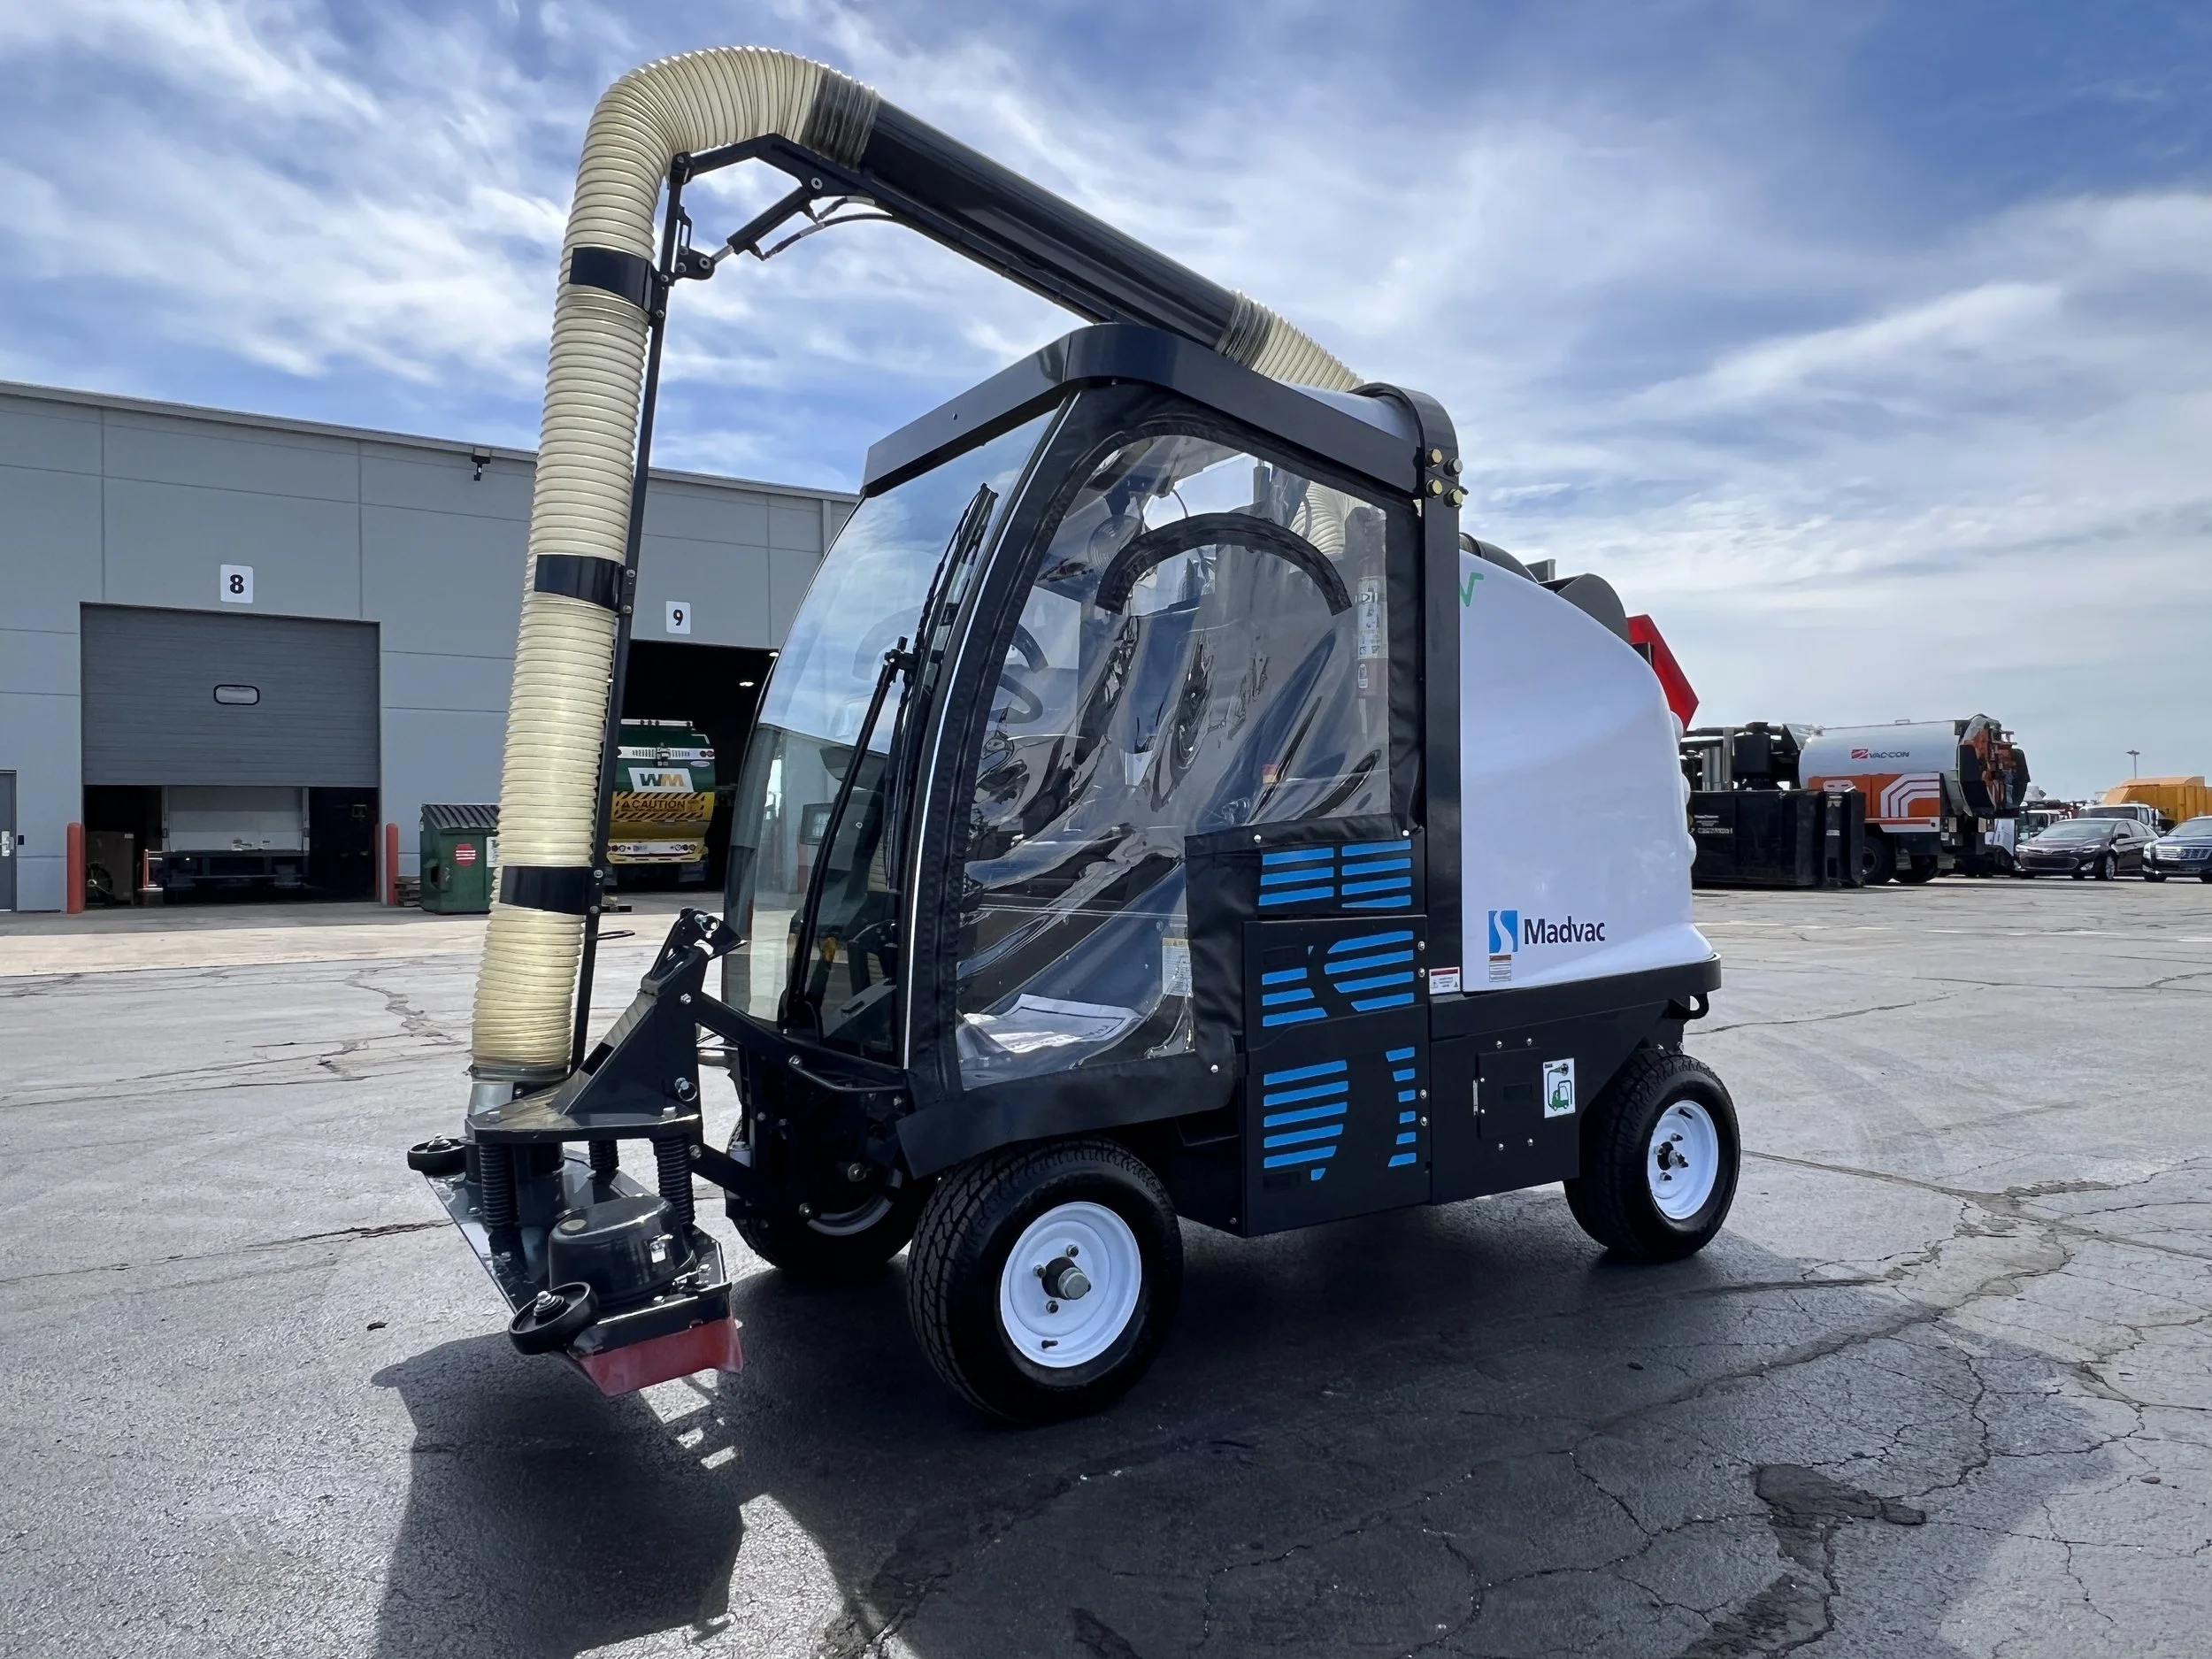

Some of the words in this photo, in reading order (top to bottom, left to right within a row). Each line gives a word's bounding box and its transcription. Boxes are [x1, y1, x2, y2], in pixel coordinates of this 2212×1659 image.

[230, 573, 244, 595] 8
[672, 609, 684, 626] 9
[639, 773, 684, 787] WM
[632, 799, 686, 810] CAUTION
[1524, 915, 1606, 945] Madvac
